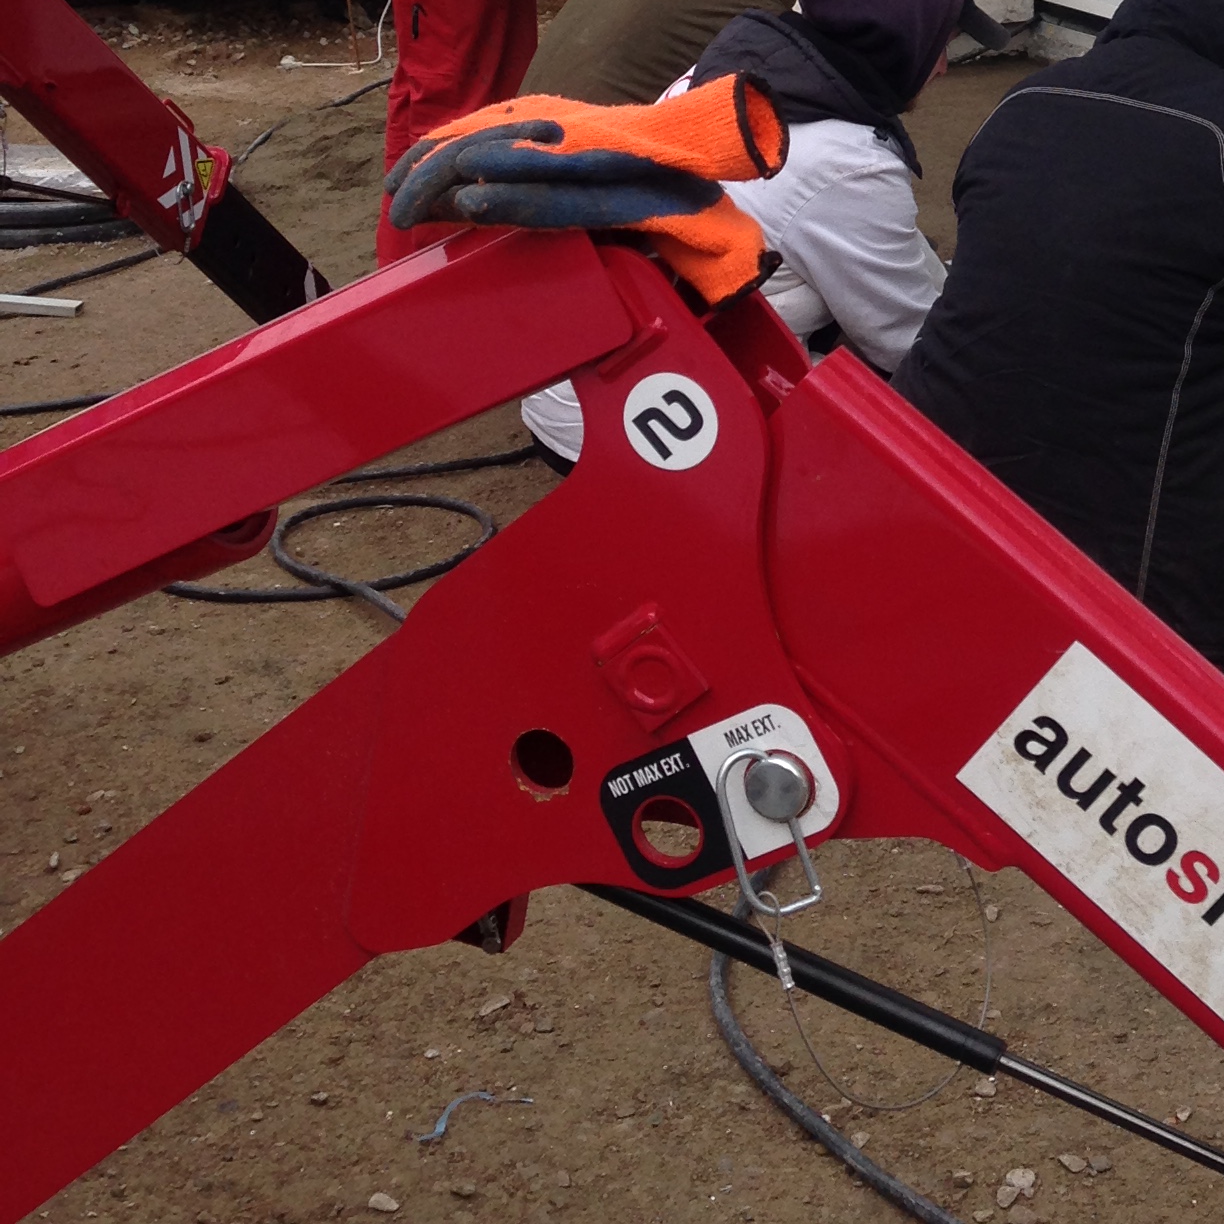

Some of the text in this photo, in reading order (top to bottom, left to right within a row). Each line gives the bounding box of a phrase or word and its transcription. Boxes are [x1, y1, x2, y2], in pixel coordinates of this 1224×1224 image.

[632, 388, 704, 461] 2
[723, 714, 781, 749] MAX EXT.
[607, 752, 690, 799] NOT MAX EXT.
